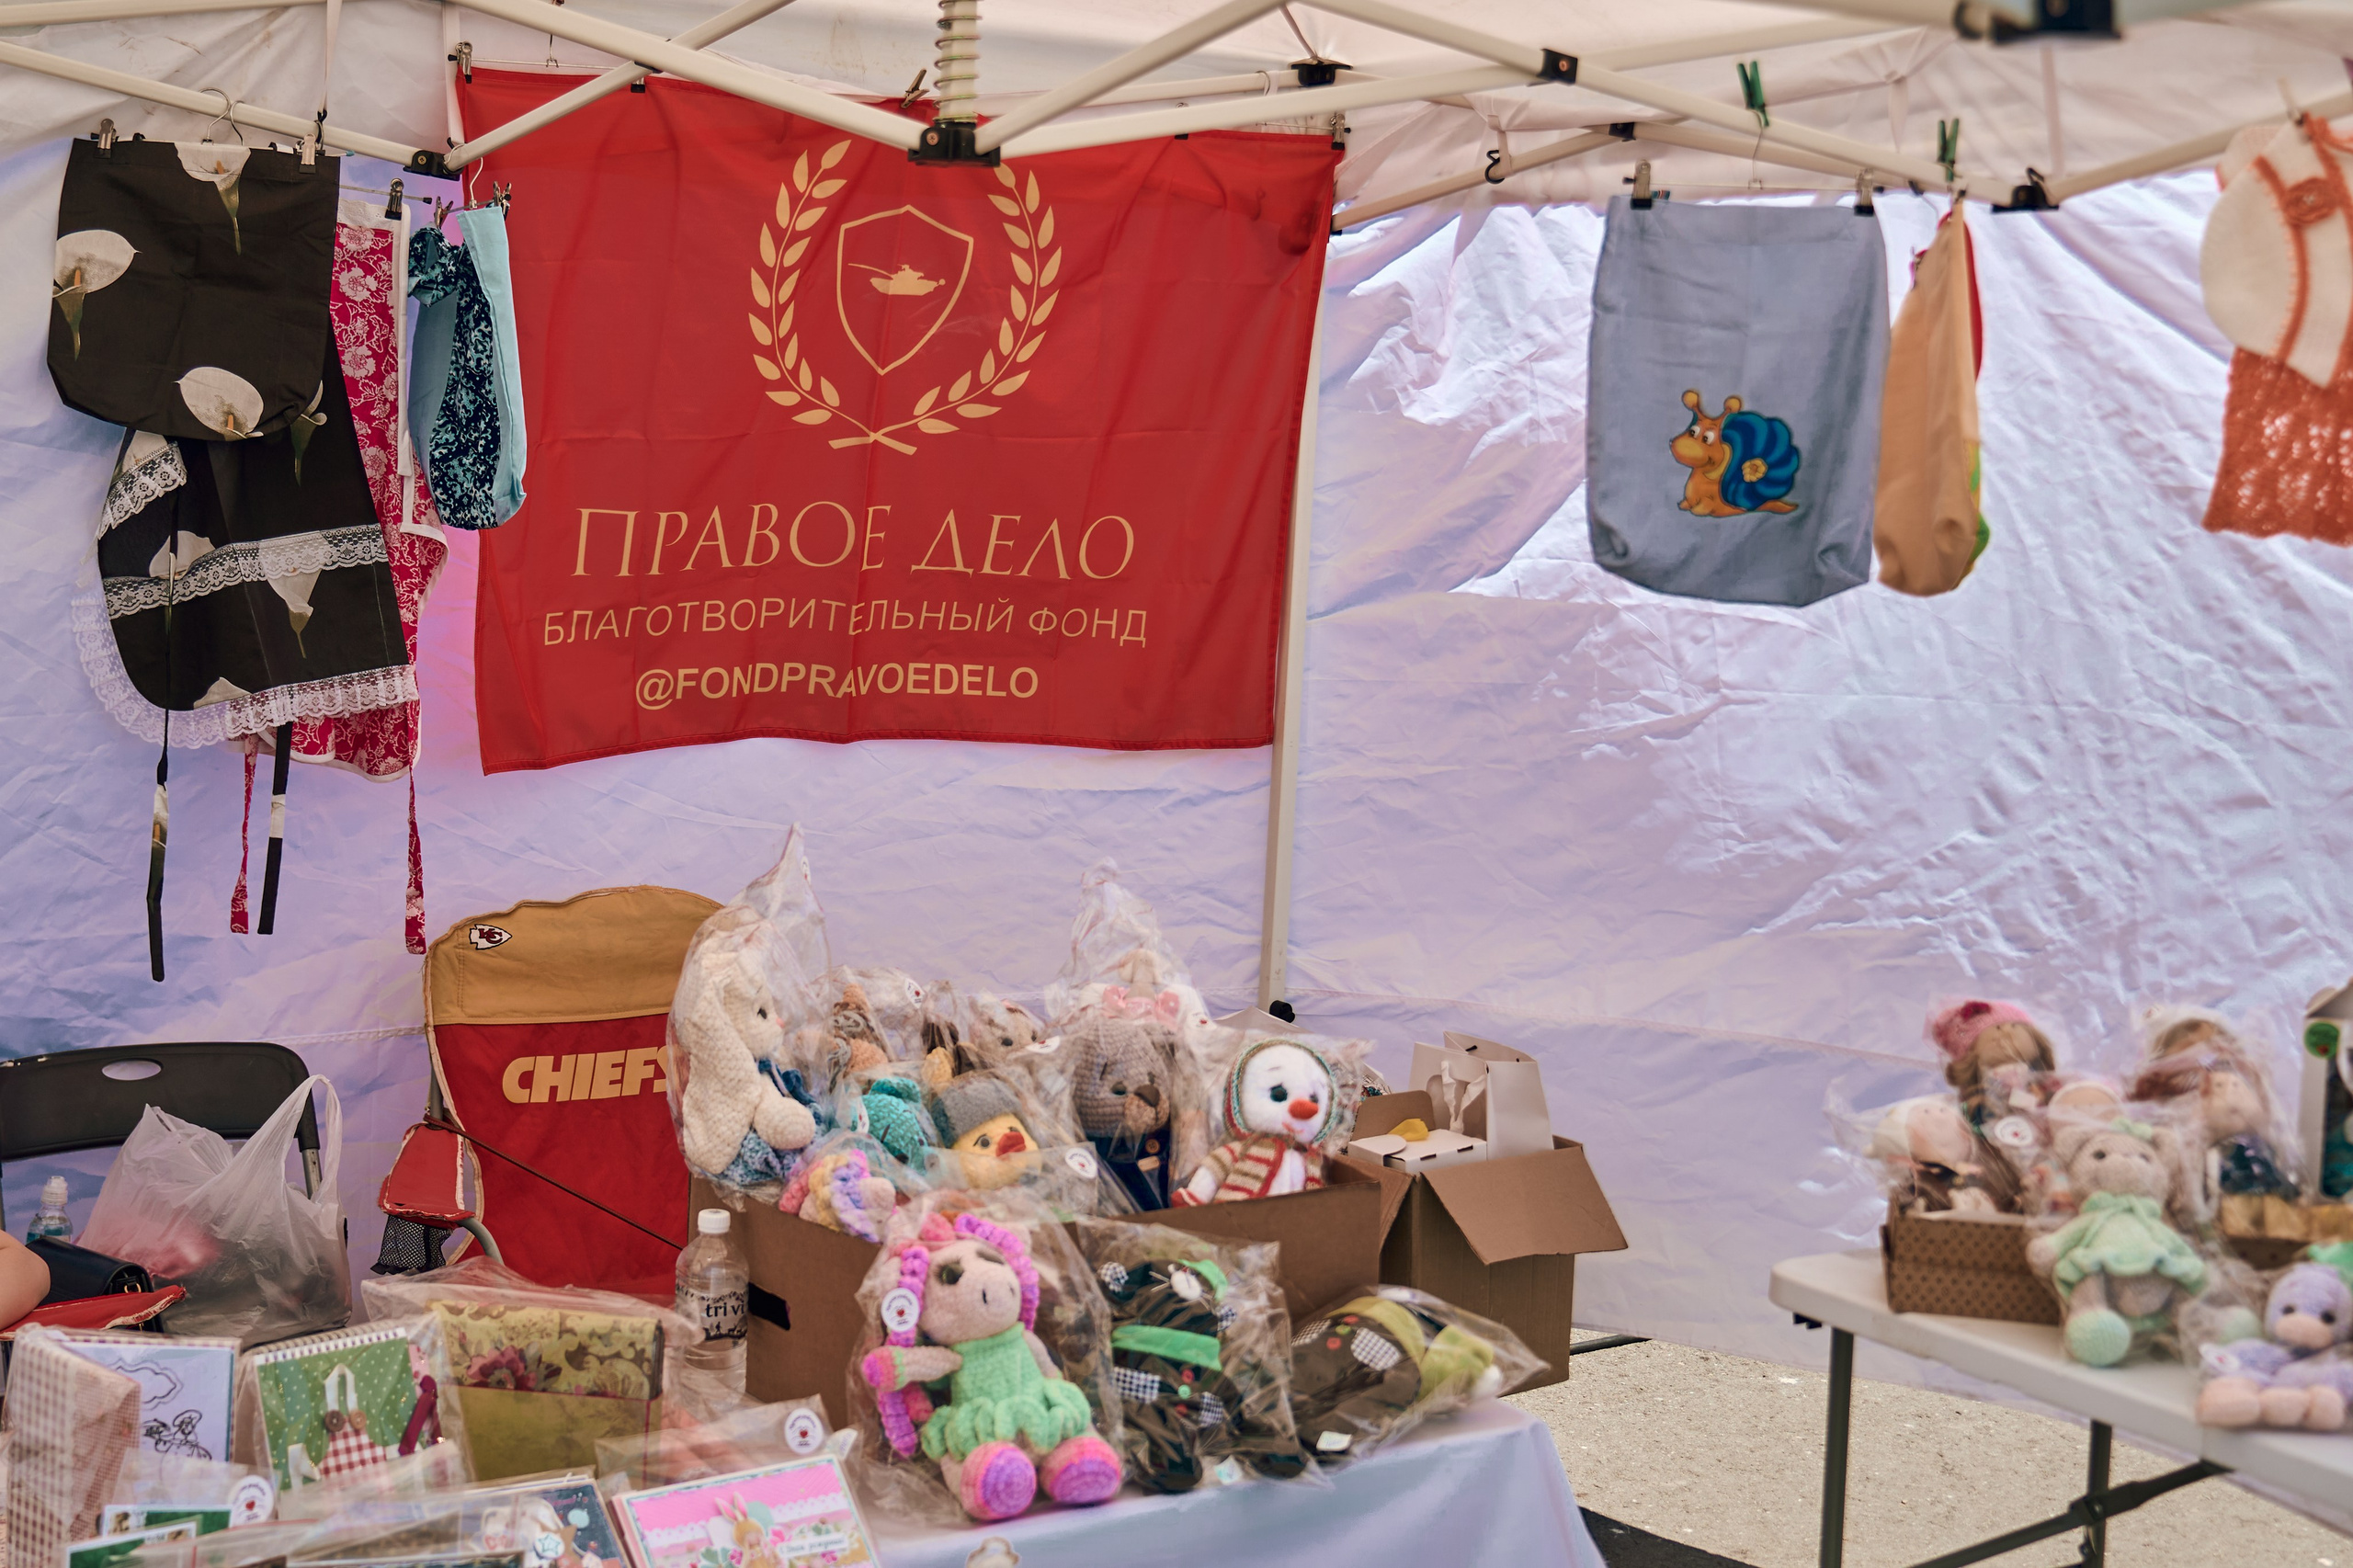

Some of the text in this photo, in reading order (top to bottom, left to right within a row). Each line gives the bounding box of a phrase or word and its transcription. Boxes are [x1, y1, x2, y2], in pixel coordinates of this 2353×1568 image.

[572, 501, 1134, 580] ПРАВОЕ ДЕЛО
[544, 597, 1147, 648] БЛАГОТВОРИТЕЛЬНЫЙ ФОНД
[635, 662, 1039, 710] @FONDPRAVOEDELO
